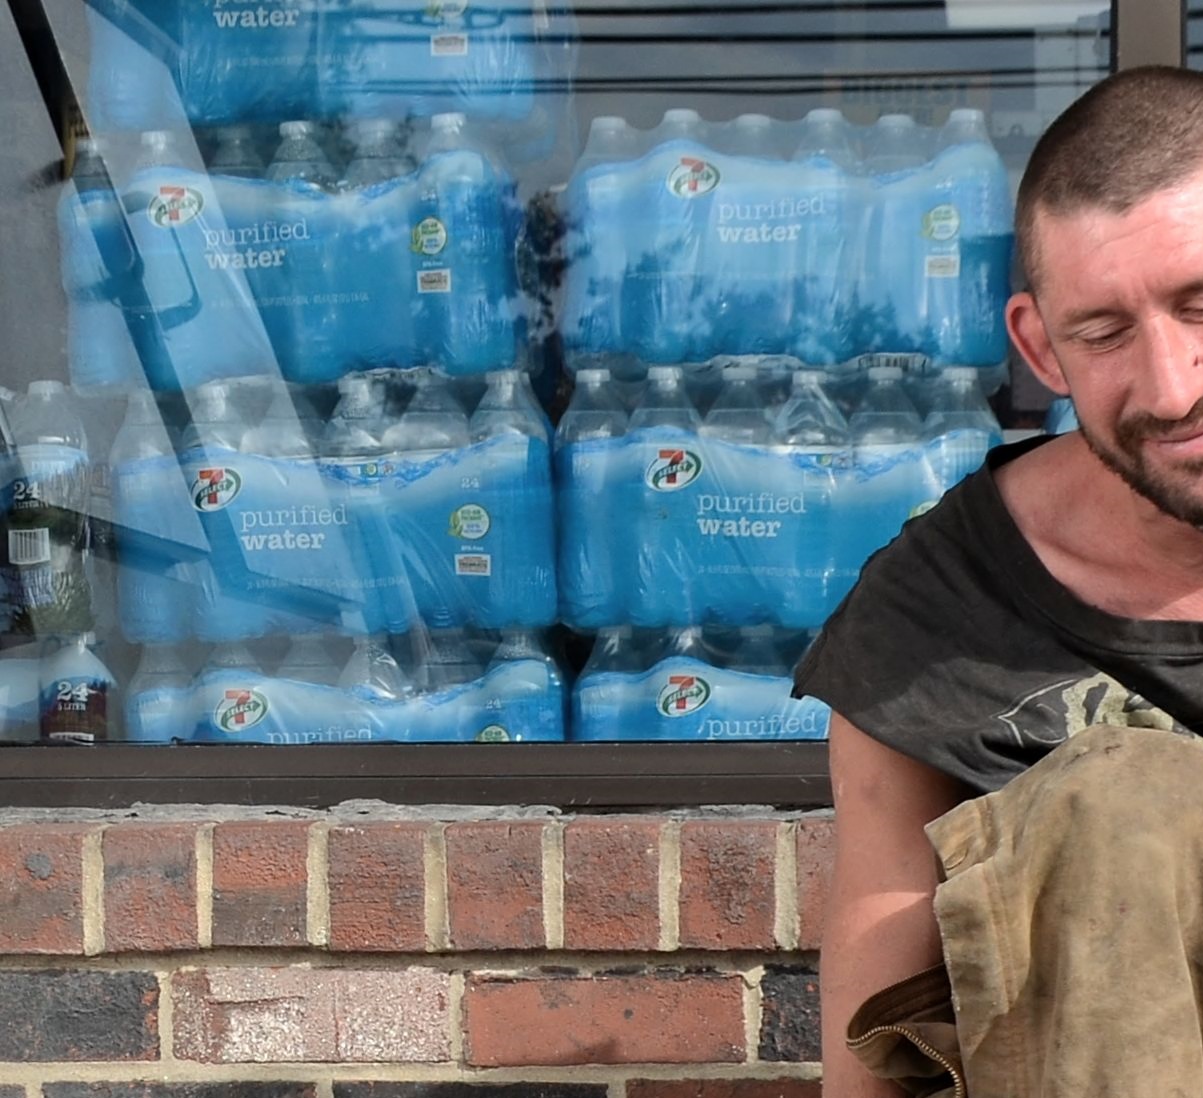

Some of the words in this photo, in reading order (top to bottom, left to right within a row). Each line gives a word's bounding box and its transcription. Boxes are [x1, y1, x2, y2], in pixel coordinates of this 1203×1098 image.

[213, 7, 299, 28] water
[681, 158, 705, 191] 7
[160, 186, 185, 221] 7
[719, 192, 826, 223] purified
[205, 217, 311, 249] purified
[717, 223, 802, 243] water
[204, 248, 286, 269] water
[659, 449, 684, 483] 7
[13, 480, 41, 499] 24
[199, 469, 223, 504] 7
[240, 504, 347, 532] purified
[697, 493, 807, 516] purified
[241, 529, 325, 550] water
[697, 516, 782, 537] water
[57, 681, 88, 701] 24
[669, 676, 695, 709] 7
[225, 690, 252, 724] 7
[267, 725, 372, 744] purified
[707, 712, 817, 740] purified
